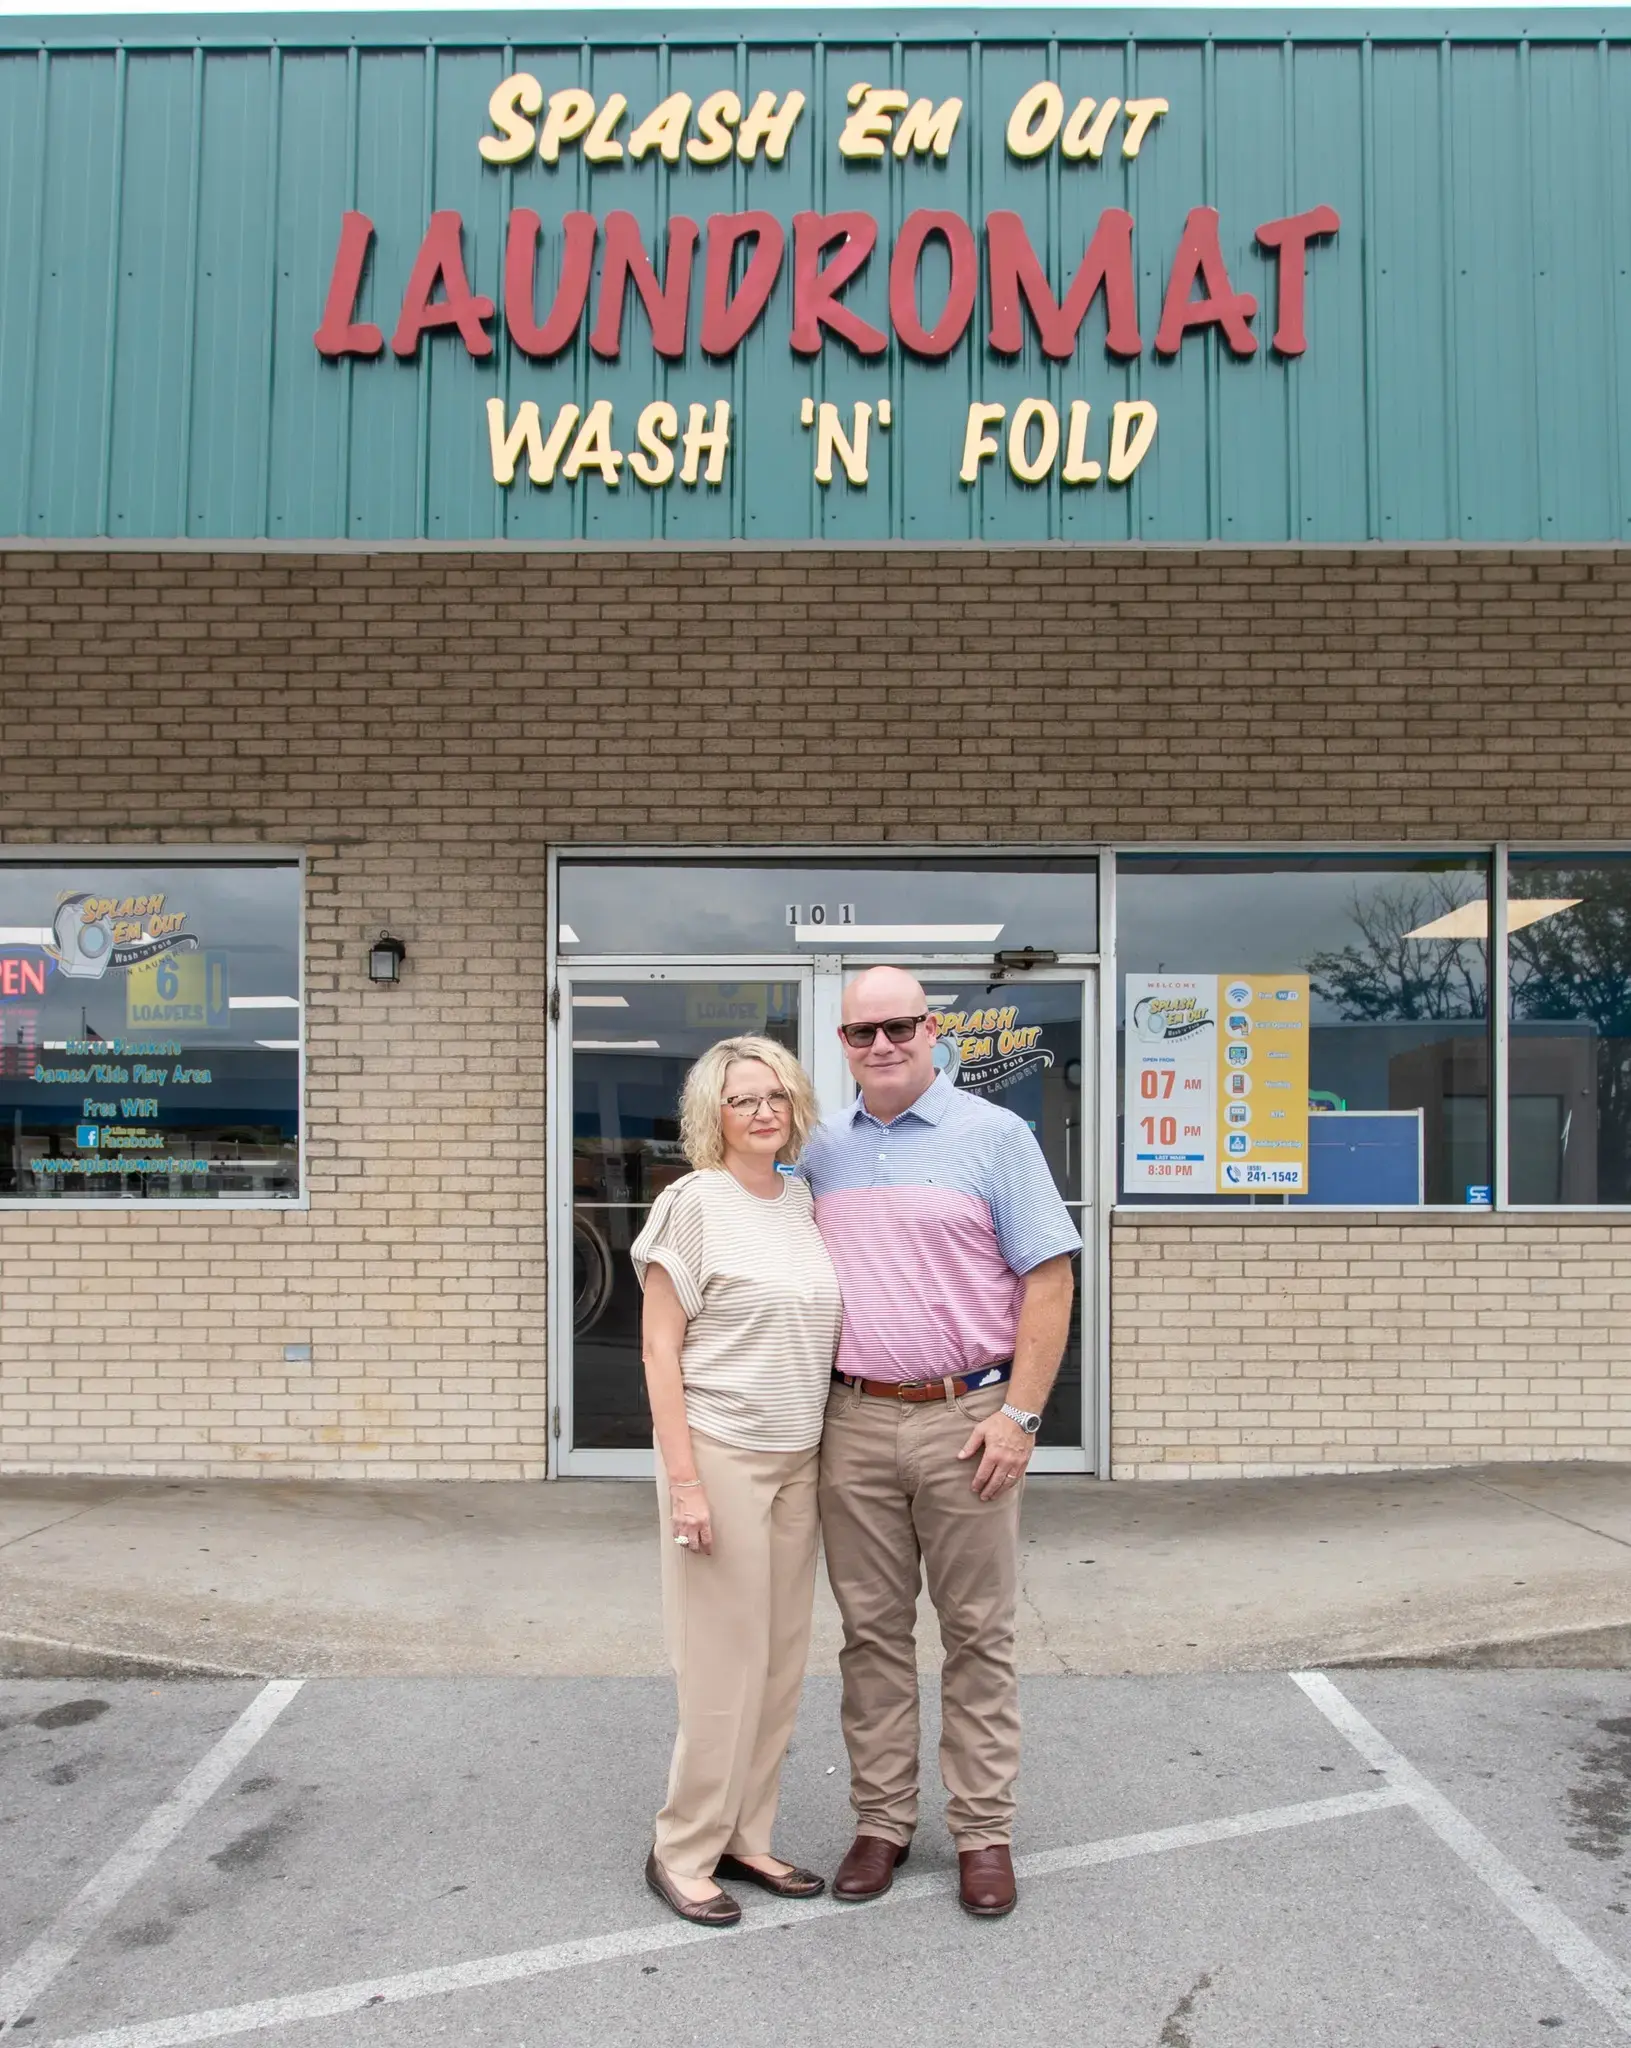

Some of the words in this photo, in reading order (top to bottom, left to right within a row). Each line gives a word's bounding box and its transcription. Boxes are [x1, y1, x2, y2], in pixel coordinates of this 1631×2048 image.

[314, 207, 1341, 360] LAUNDROMAT
[487, 398, 730, 485] WASH
[960, 400, 1158, 485] FOLD
[80, 893, 166, 924] SPLASH
[149, 912, 187, 938] OUT
[156, 957, 179, 1001] 6
[132, 1004, 205, 1022] LOADERS
[1149, 998, 1198, 1014] SPLASH
[1188, 1008, 1210, 1023] OUT
[998, 1026, 1041, 1056] OUT
[132, 1064, 168, 1086] Play
[171, 1064, 212, 1083] Area
[962, 1069, 988, 1083] Wash
[1002, 1057, 1024, 1071] Fold
[987, 1063, 1039, 1094] LAUNDRY
[1140, 1070, 1176, 1100] 07
[1184, 1079, 1202, 1090] AM
[83, 1098, 116, 1117] Free
[101, 1133, 164, 1148] Facebook
[1140, 1116, 1177, 1146] 10
[1184, 1126, 1202, 1137] PM
[1148, 1164, 1172, 1176] 8:30
[1174, 1164, 1193, 1176] PM
[1247, 1171, 1298, 1182] 241-1542
